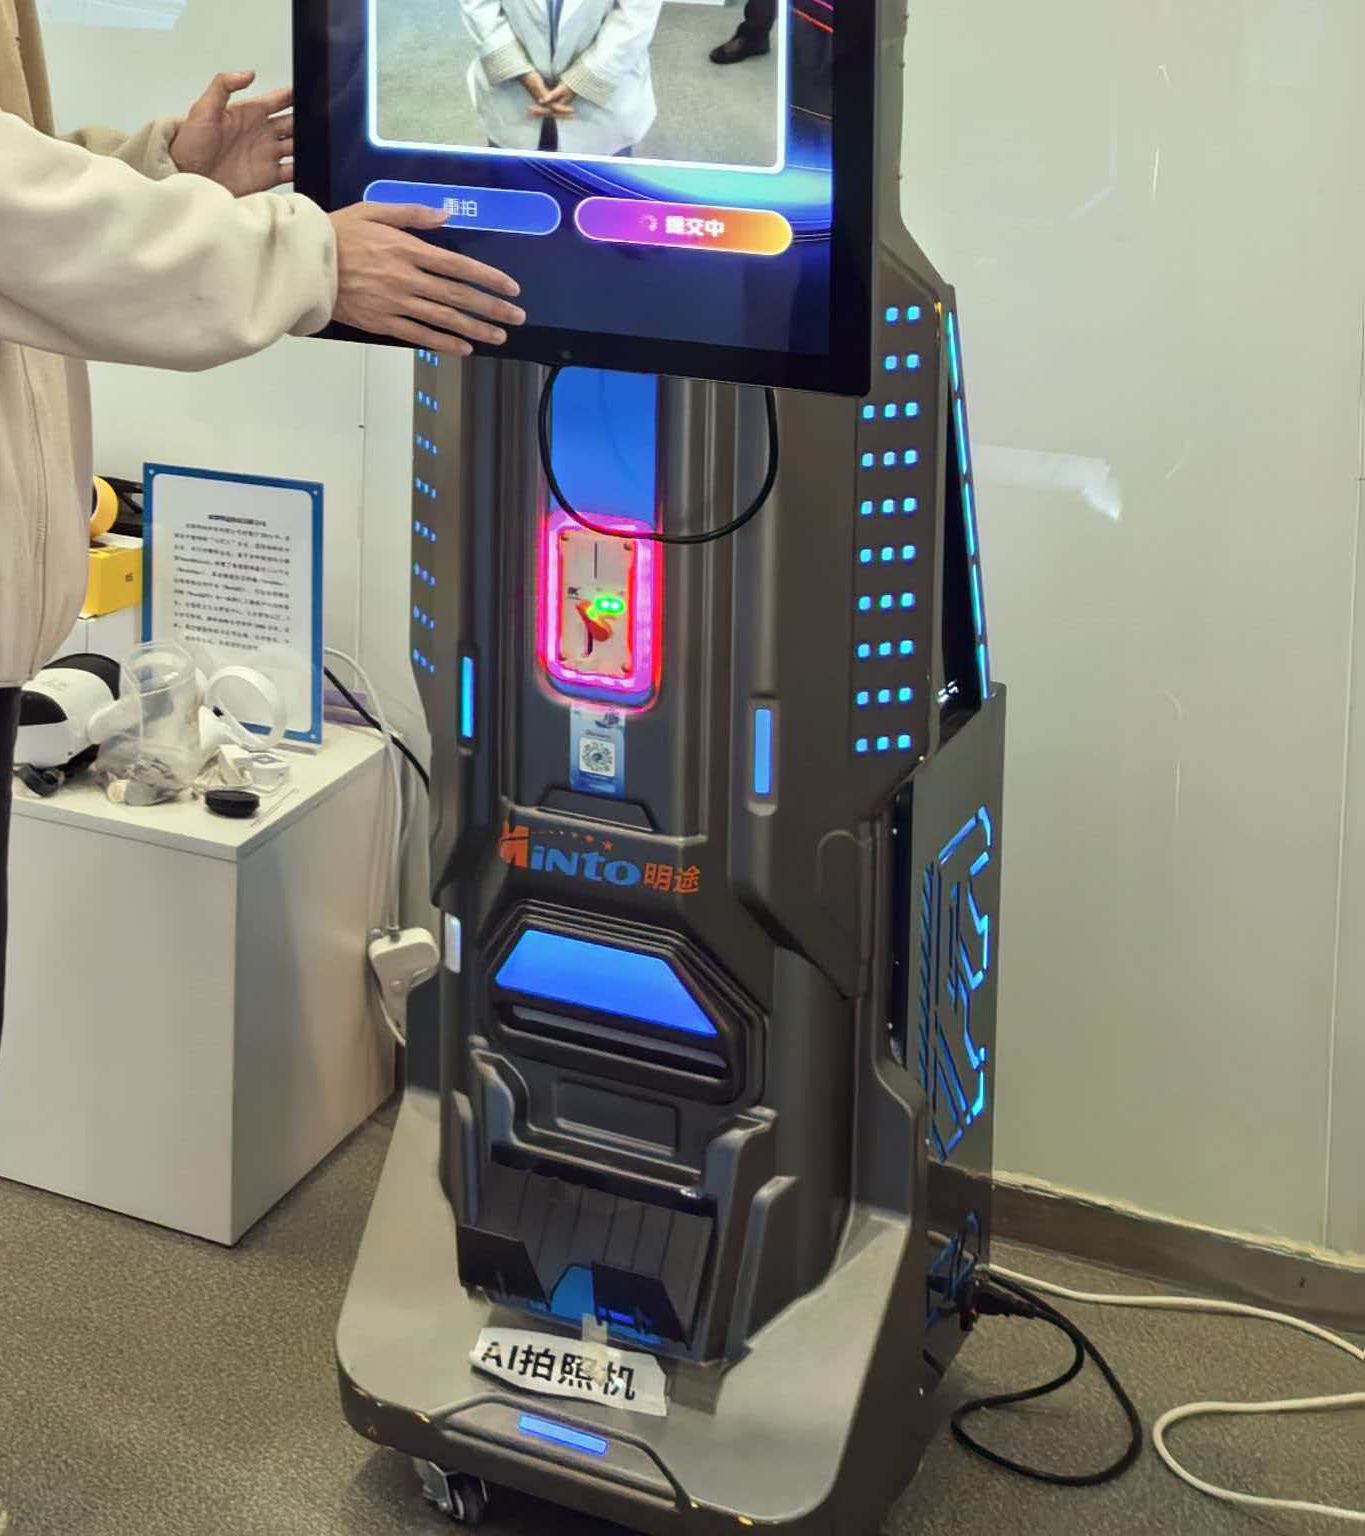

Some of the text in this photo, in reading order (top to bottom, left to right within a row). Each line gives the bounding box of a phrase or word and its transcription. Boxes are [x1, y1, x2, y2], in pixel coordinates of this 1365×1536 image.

[643, 863, 702, 894] 明途
[481, 1341, 636, 1401] AI拍照机
